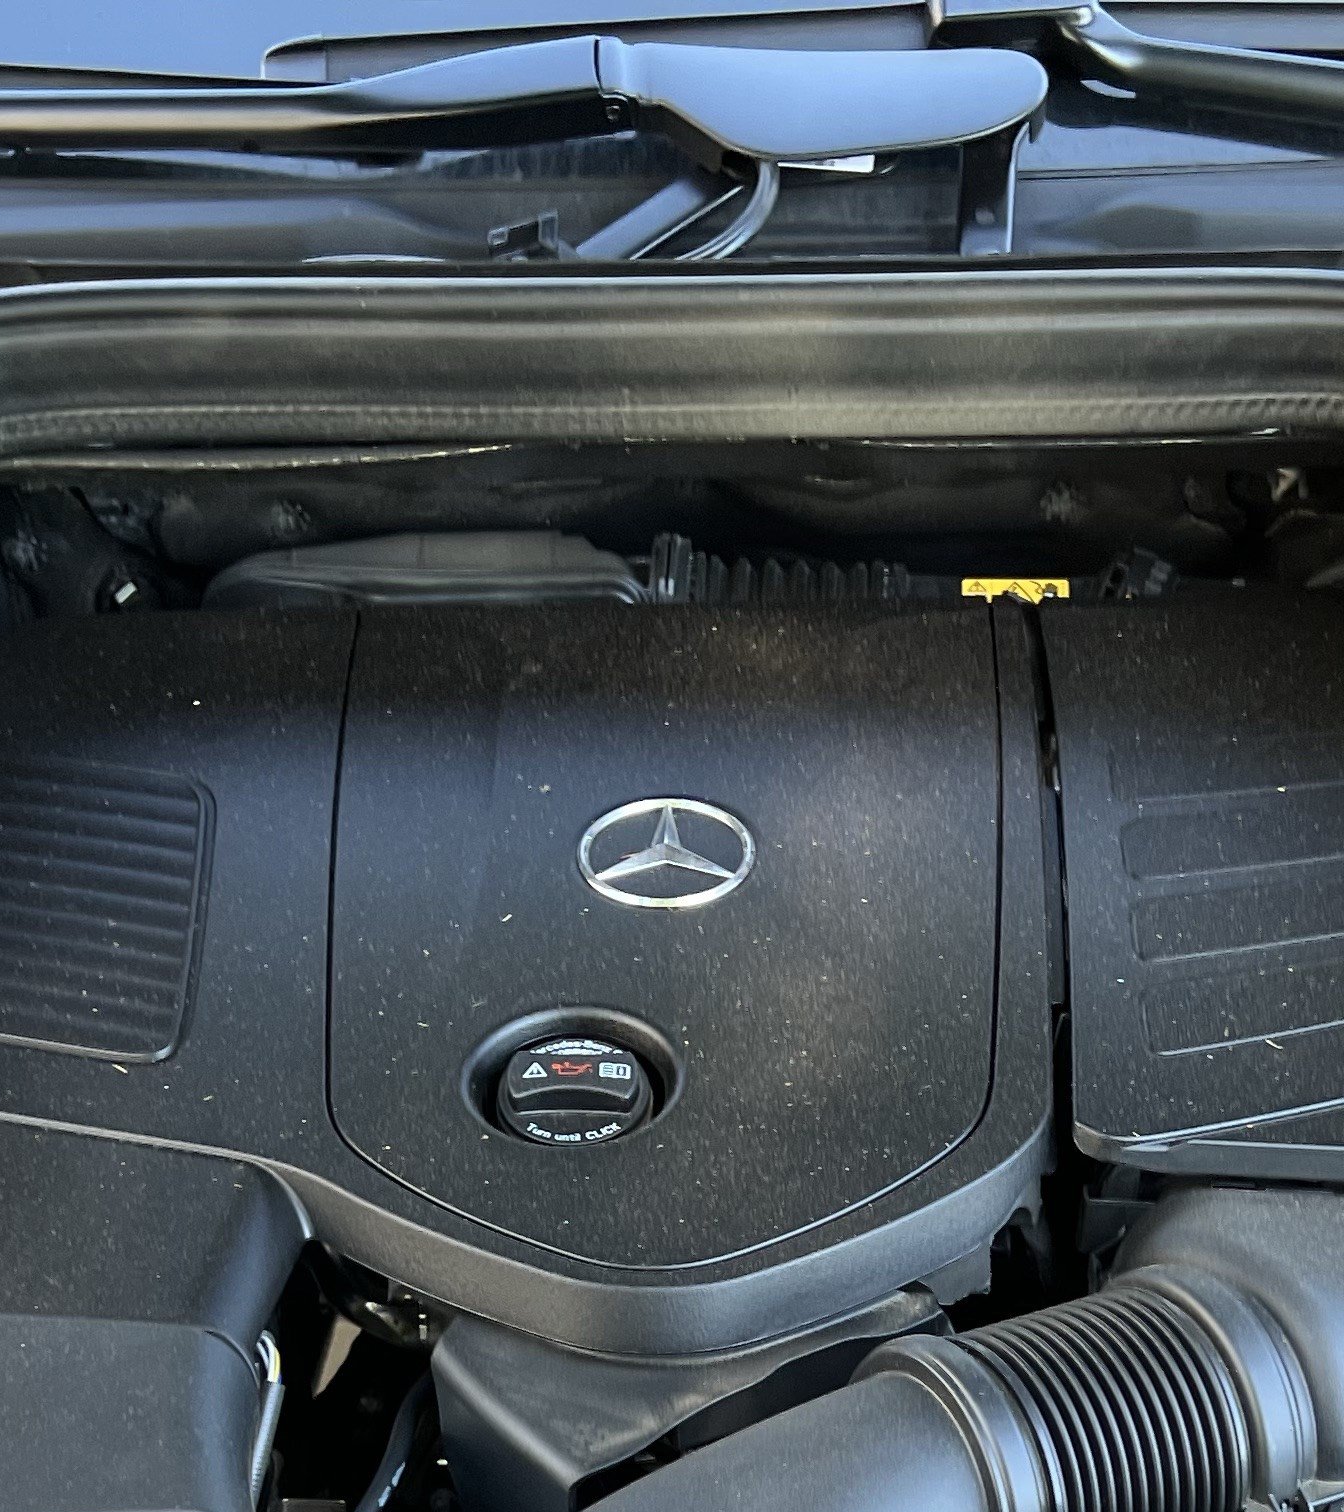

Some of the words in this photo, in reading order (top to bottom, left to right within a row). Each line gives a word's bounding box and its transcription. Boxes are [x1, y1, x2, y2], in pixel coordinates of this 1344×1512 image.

[527, 1122, 551, 1139] Turn
[554, 1132, 582, 1141] until
[585, 1122, 622, 1140] CLICK
